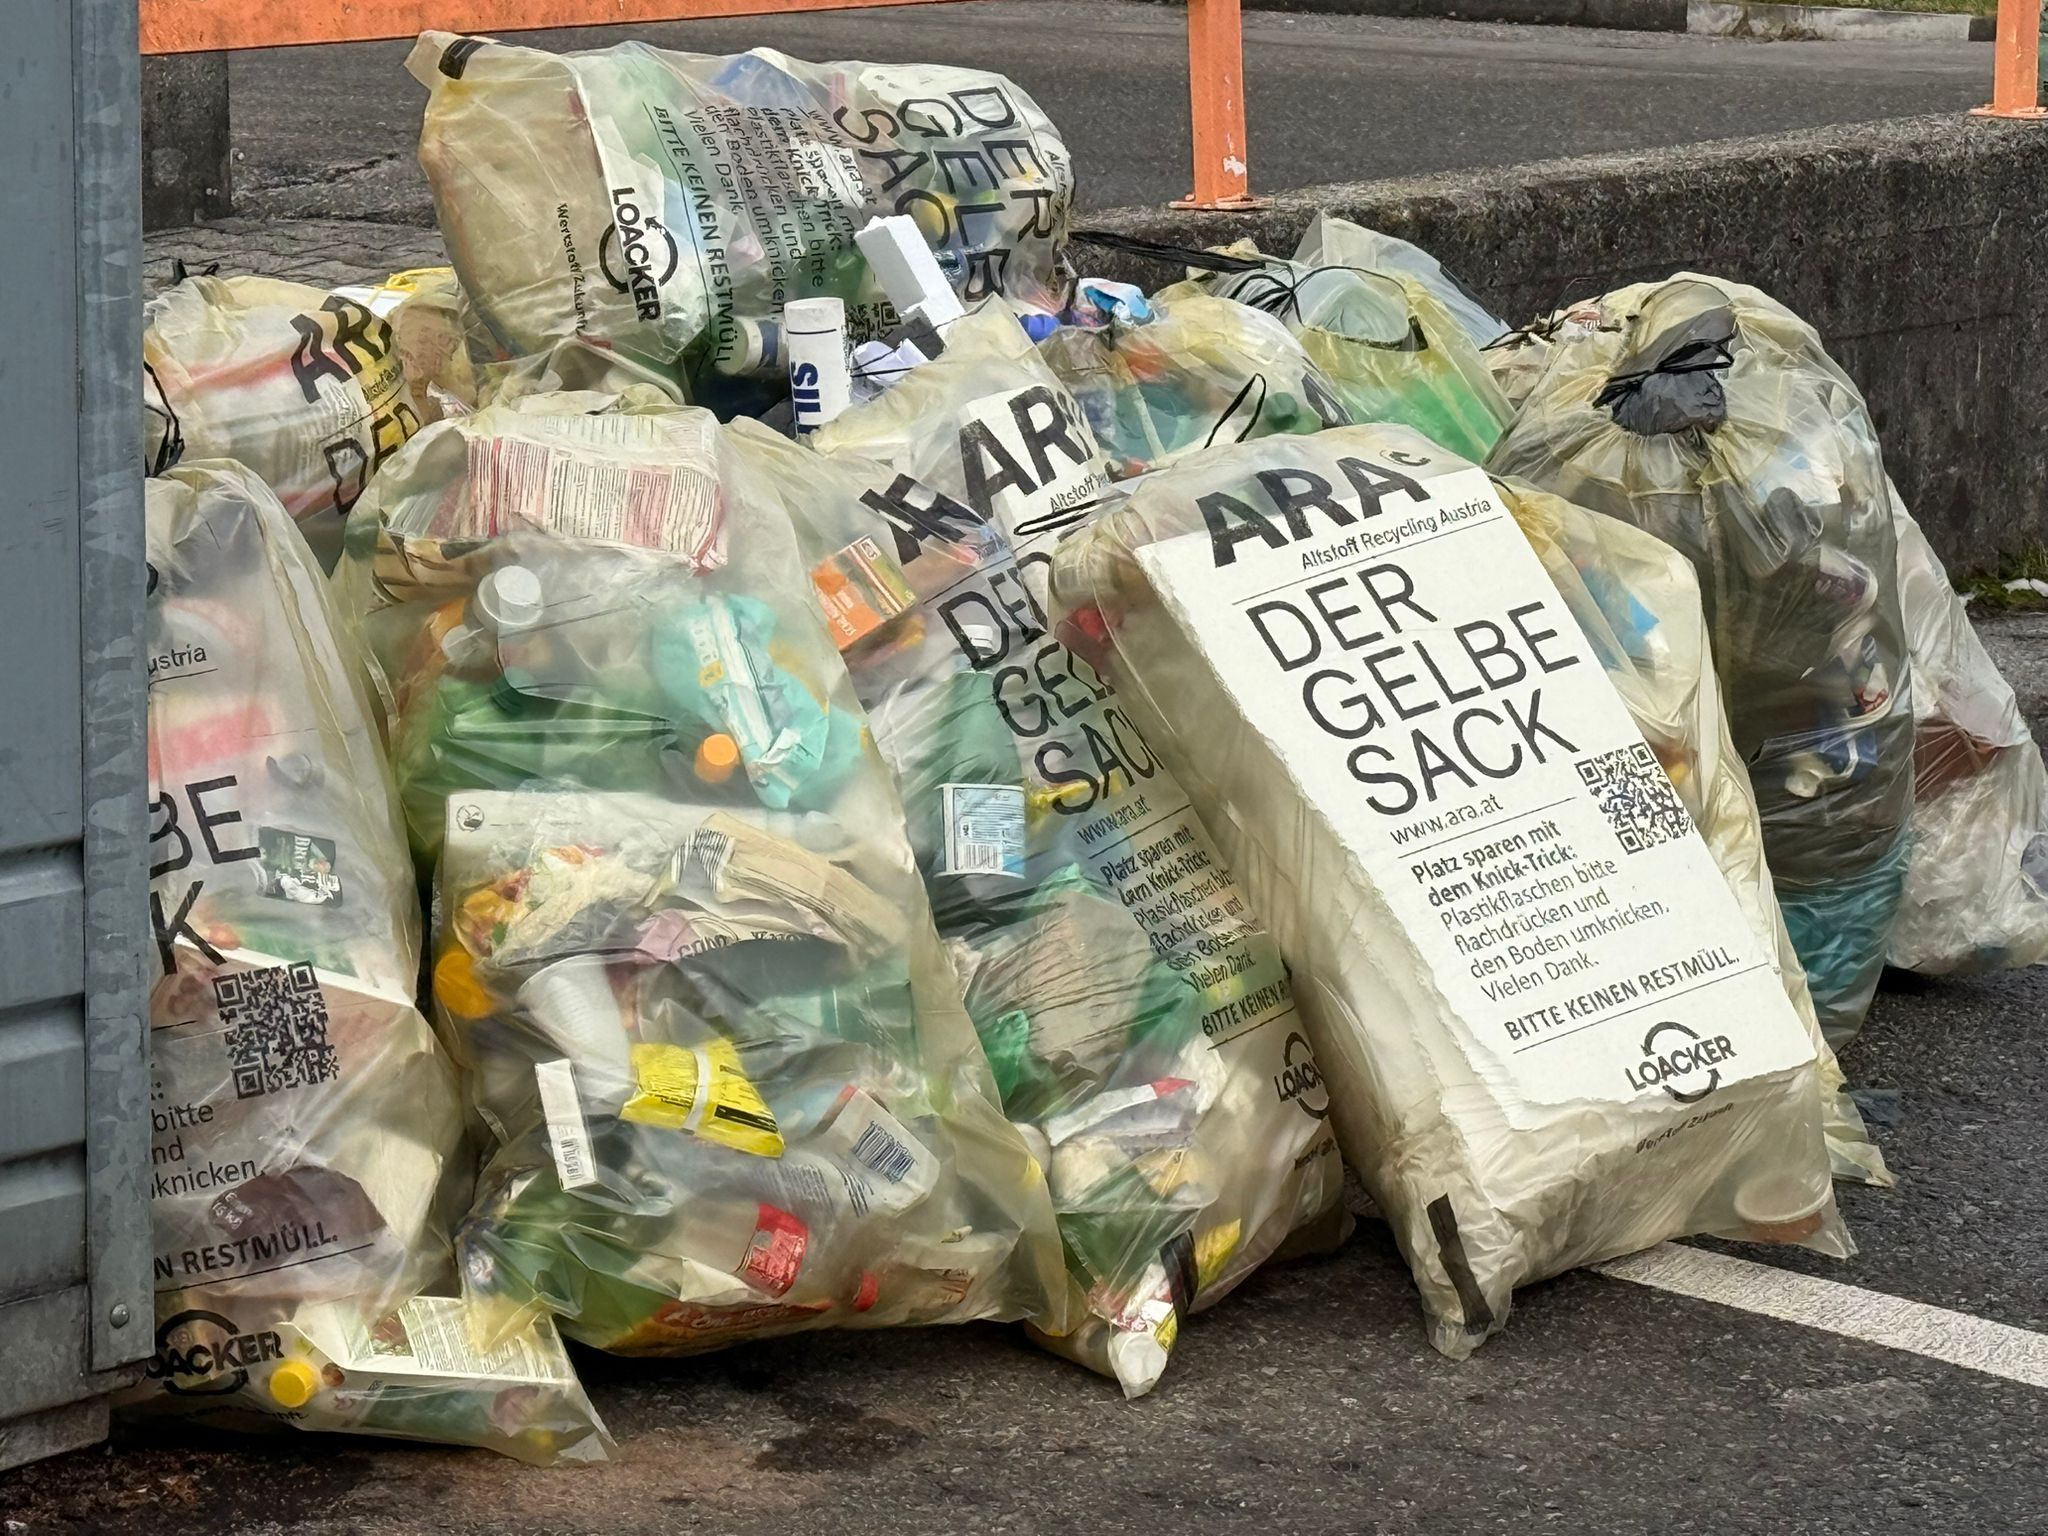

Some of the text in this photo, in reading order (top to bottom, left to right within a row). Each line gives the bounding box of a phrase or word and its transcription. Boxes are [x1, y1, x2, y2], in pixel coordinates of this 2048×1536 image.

[684, 109, 720, 157] Vielen
[948, 86, 1055, 242] DER
[654, 106, 690, 158] BITTE
[682, 162, 721, 241] KEINEN
[833, 106, 949, 249] SAC
[896, 99, 1011, 301] GELB
[612, 187, 661, 322] LOACKER
[780, 223, 806, 260] und
[808, 239, 826, 288] bitte
[1196, 456, 1432, 568] ARA
[1301, 497, 1493, 570] Altstoff Recycling Austria
[1246, 563, 1438, 672] DER
[148, 643, 207, 676] ustria
[1302, 601, 1581, 740] GELBE
[1346, 688, 1581, 816] SACK
[1390, 793, 1505, 845] www.ara.at
[1411, 819, 1562, 884] Platz sparen mit
[1427, 843, 1578, 907] dem Knick-Trick:
[1440, 858, 1618, 932] Plastikflaschen bitte
[1454, 885, 1611, 956] flachdrücken und
[1470, 951, 1508, 980] den
[1507, 932, 1570, 966] Boden
[1480, 949, 1600, 1003] Vielen Dank.
[1201, 1003, 1241, 1037] BITTE
[1239, 984, 1281, 1020] KEINEN
[1504, 945, 1740, 1041] BITTE KEINEN RESTMÜLL.
[1624, 1035, 1738, 1091] LOACKER
[151, 1135, 185, 1165] nd
[151, 1159, 266, 1200] knicken.
[182, 1221, 338, 1275] RESTMÜLL.
[146, 1331, 285, 1379] OACKER
